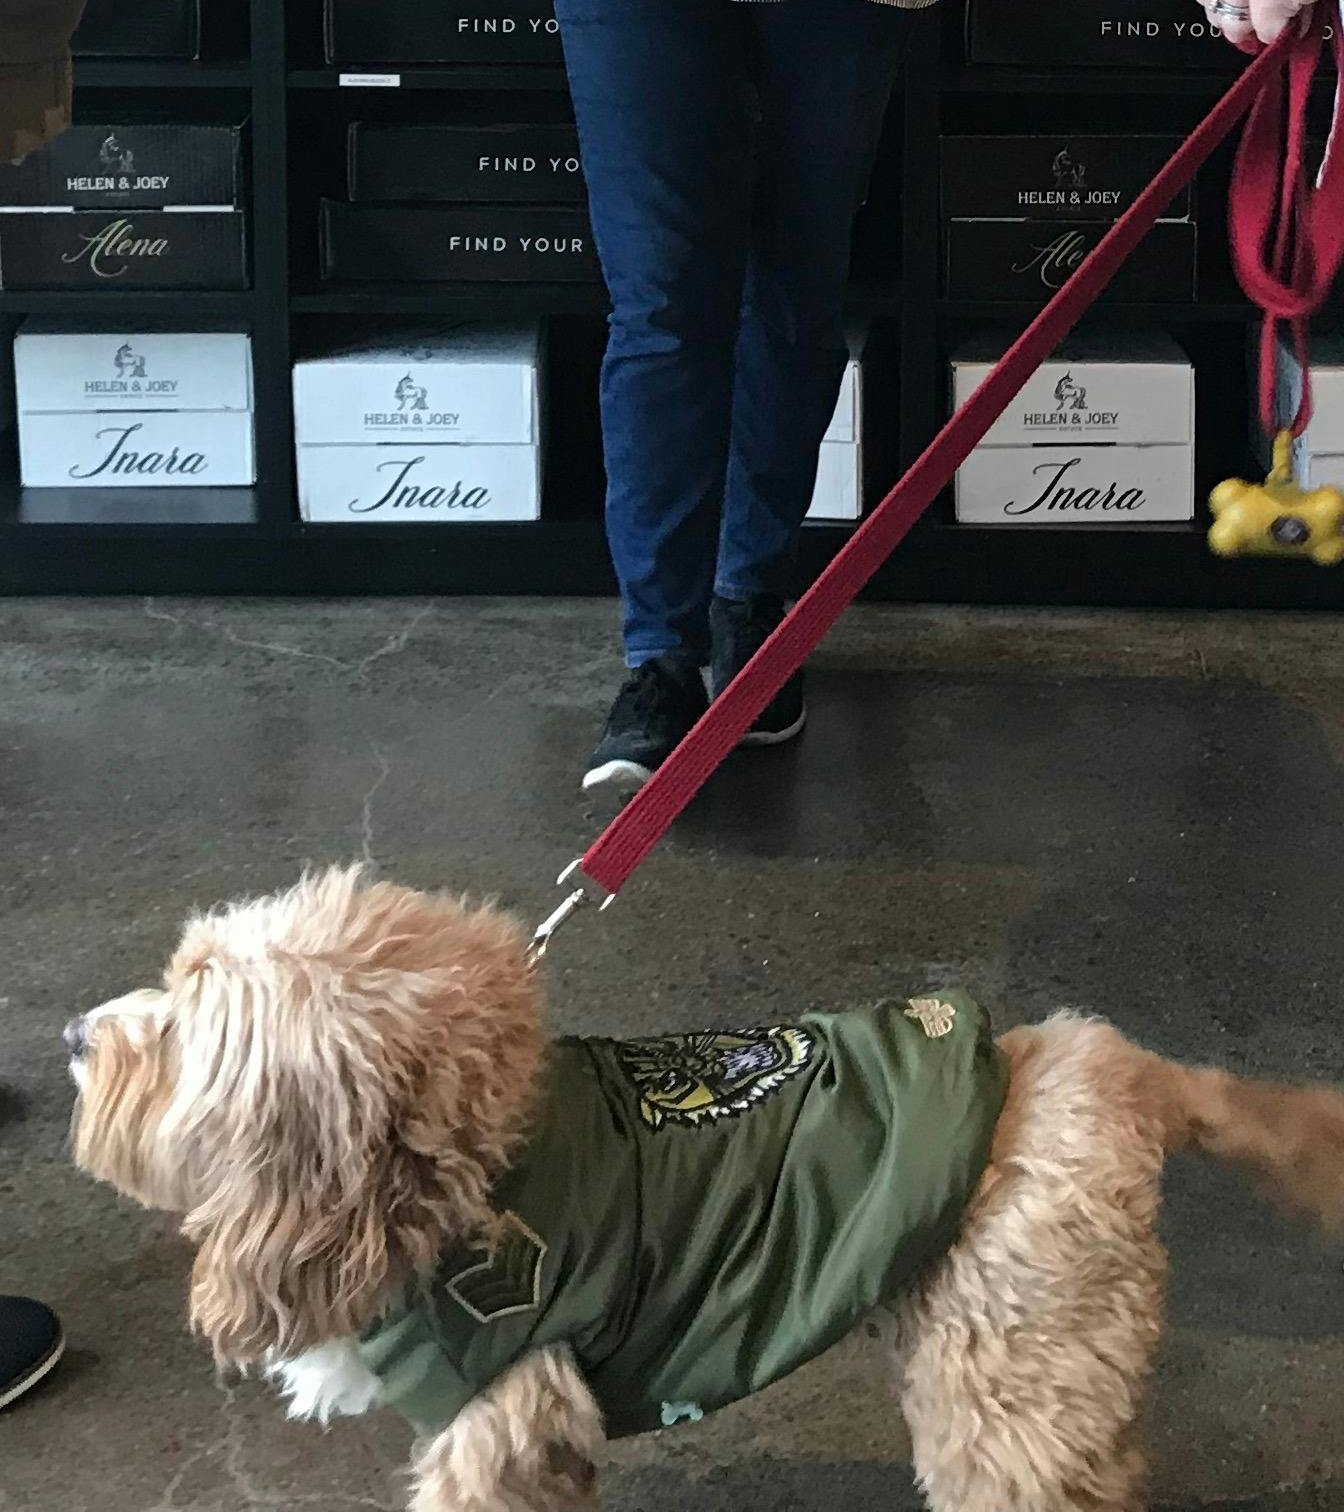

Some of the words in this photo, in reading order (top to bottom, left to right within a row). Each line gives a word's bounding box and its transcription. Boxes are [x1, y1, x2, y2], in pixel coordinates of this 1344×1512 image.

[458, 18, 516, 33] FIND
[528, 18, 560, 33] YO
[1101, 21, 1160, 37] FIND
[1173, 22, 1223, 38] YOU
[479, 156, 536, 172] FIND
[549, 157, 580, 172] YO
[67, 177, 115, 191] HELEN
[118, 176, 130, 189] &
[133, 175, 170, 190] JOEY
[1018, 191, 1065, 204] HELEN
[1069, 191, 1081, 204] &
[1084, 191, 1121, 204] JOEY
[61, 218, 169, 278] Alena
[449, 236, 507, 252] FIND
[519, 237, 583, 252] YOUR
[1011, 230, 1086, 288] Ale
[84, 380, 128, 392] HELEN
[131, 380, 142, 392] &
[145, 380, 178, 392] JOEY
[364, 413, 409, 425] HELEN
[412, 413, 423, 425] &
[426, 413, 460, 425] JOEY
[1023, 413, 1067, 425] HELEN
[1071, 412, 1081, 424] &
[1085, 412, 1119, 424] JOEY
[68, 422, 209, 479] Inara
[348, 456, 492, 513] Inara
[1003, 457, 1146, 515] Inara
